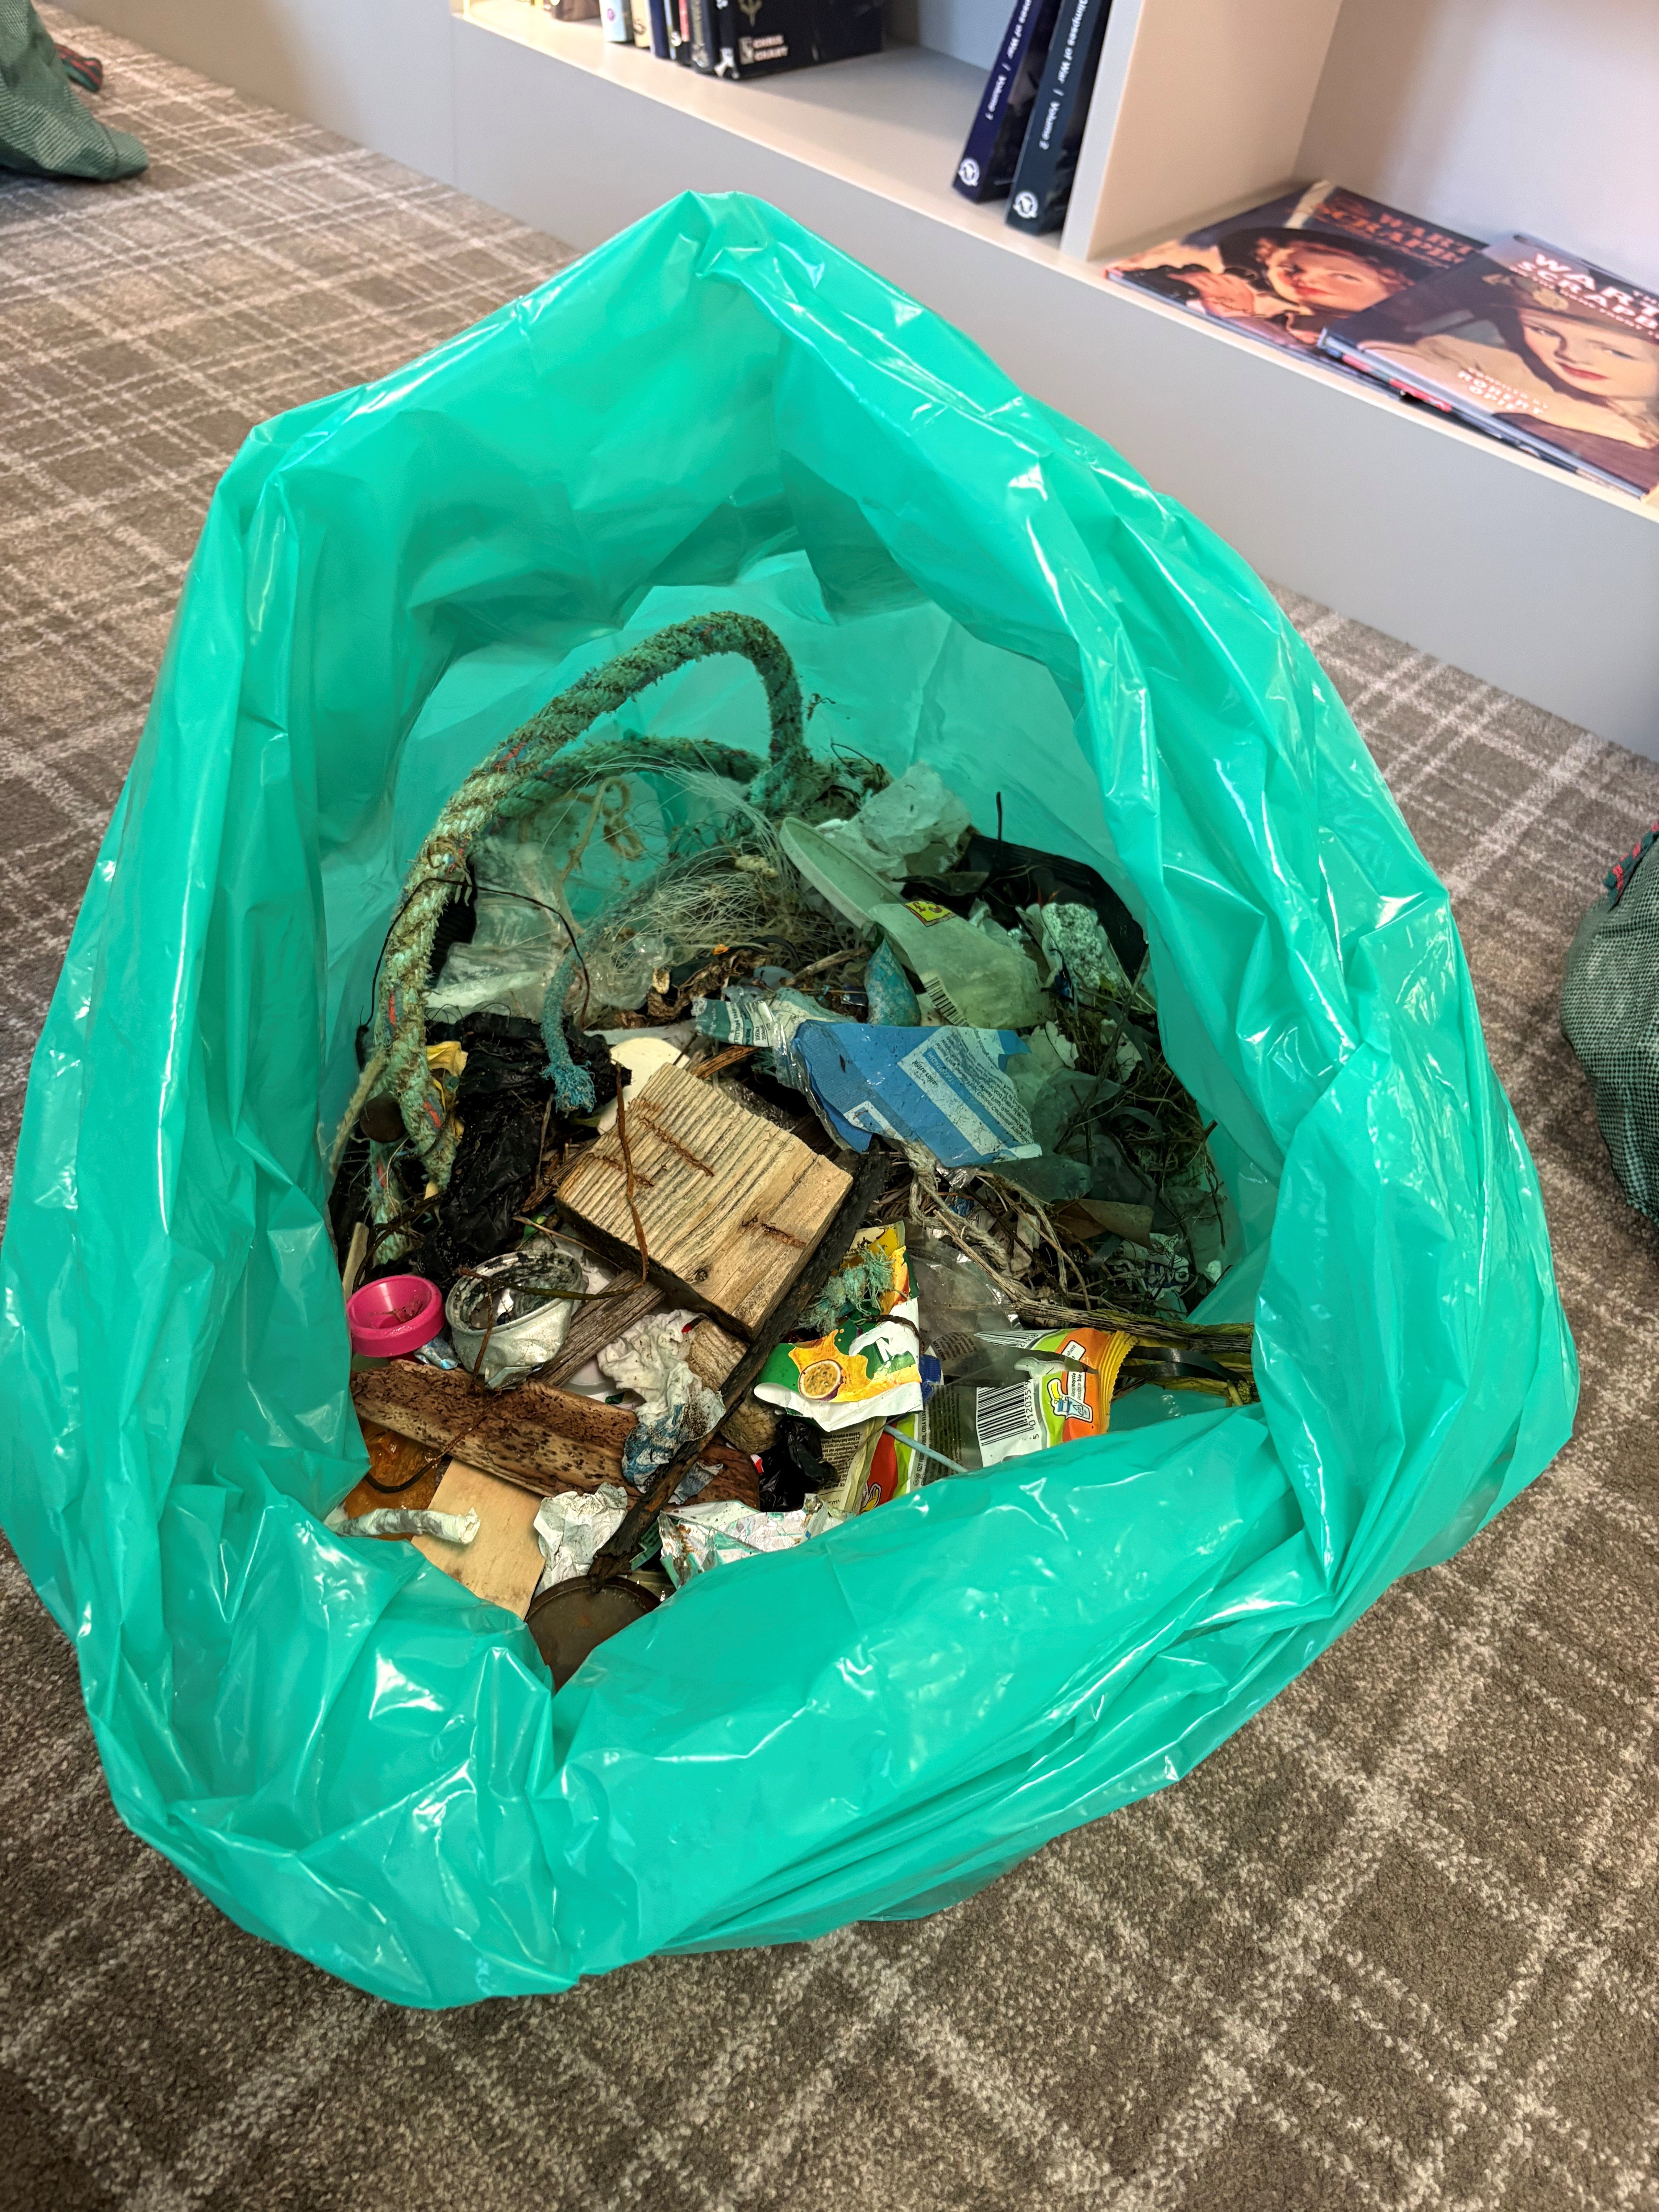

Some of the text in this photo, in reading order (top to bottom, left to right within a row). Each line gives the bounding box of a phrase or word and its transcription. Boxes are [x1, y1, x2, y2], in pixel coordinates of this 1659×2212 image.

[1007, 37, 1019, 59] War
[1014, 24, 1022, 37] of
[1064, 47, 1073, 60] of
[1058, 60, 1070, 84] War
[988, 74, 1006, 112] Volume
[1042, 101, 1061, 140] Volume
[1039, 140, 1049, 150] 2
[1519, 260, 1659, 330] SCRAPB
[1535, 254, 1659, 318] WART
[1458, 370, 1544, 415] ROBERT
[1025, 1389, 1035, 1425] 012035
